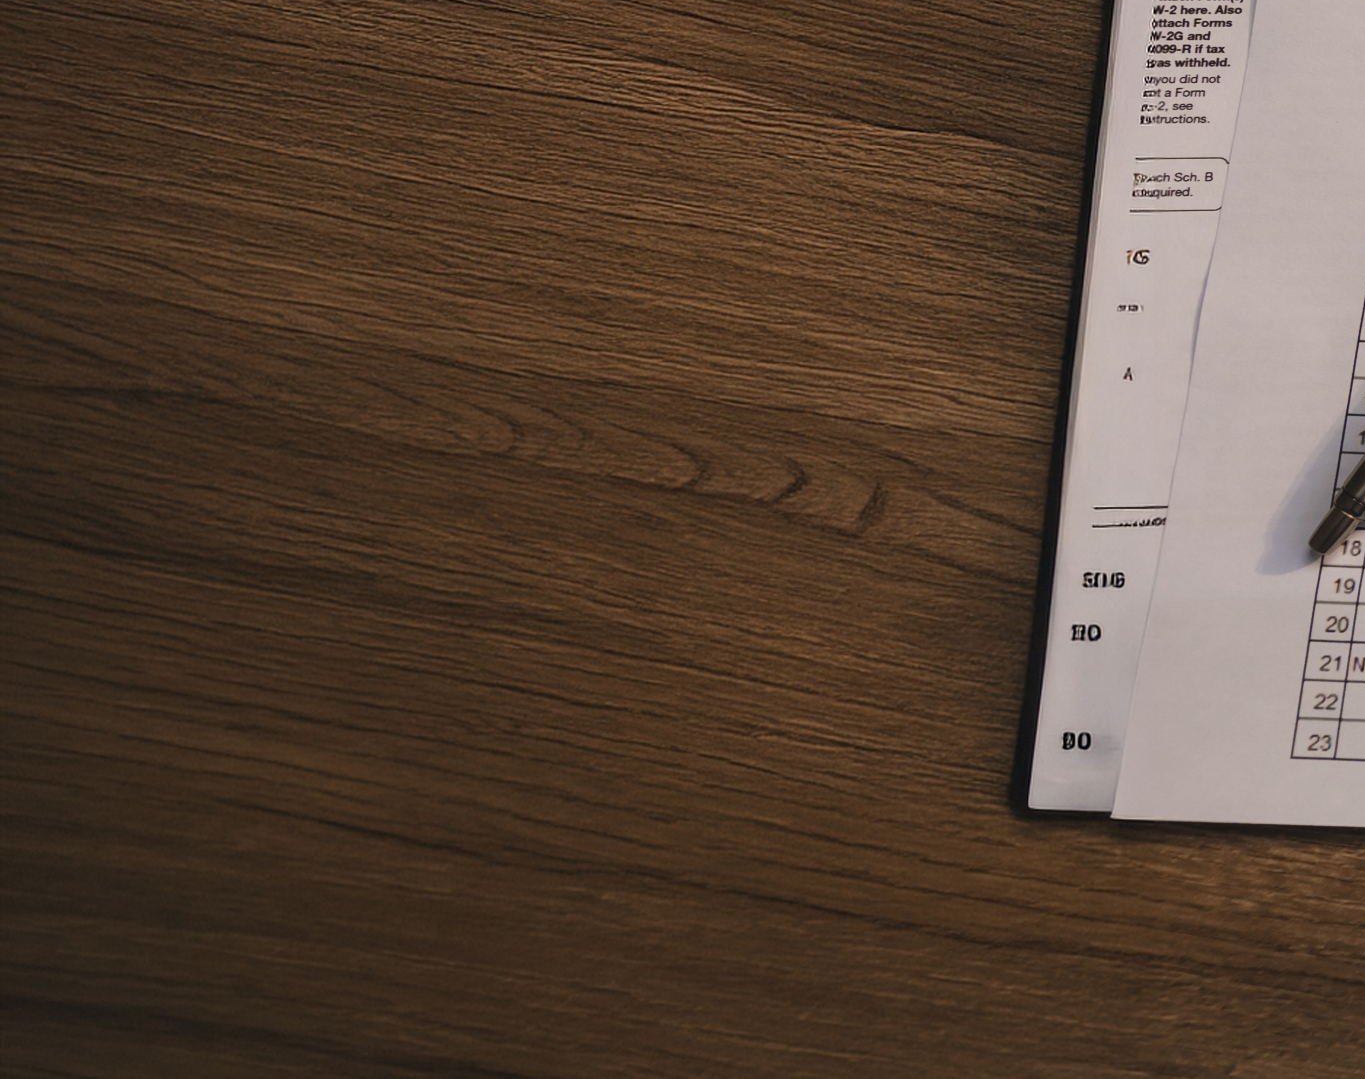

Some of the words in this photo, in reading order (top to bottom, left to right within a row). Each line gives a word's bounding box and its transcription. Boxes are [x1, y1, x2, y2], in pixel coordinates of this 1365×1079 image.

[1319, 654, 1342, 672] 21
[1313, 693, 1339, 711] 22
[1307, 734, 1332, 752] 23
